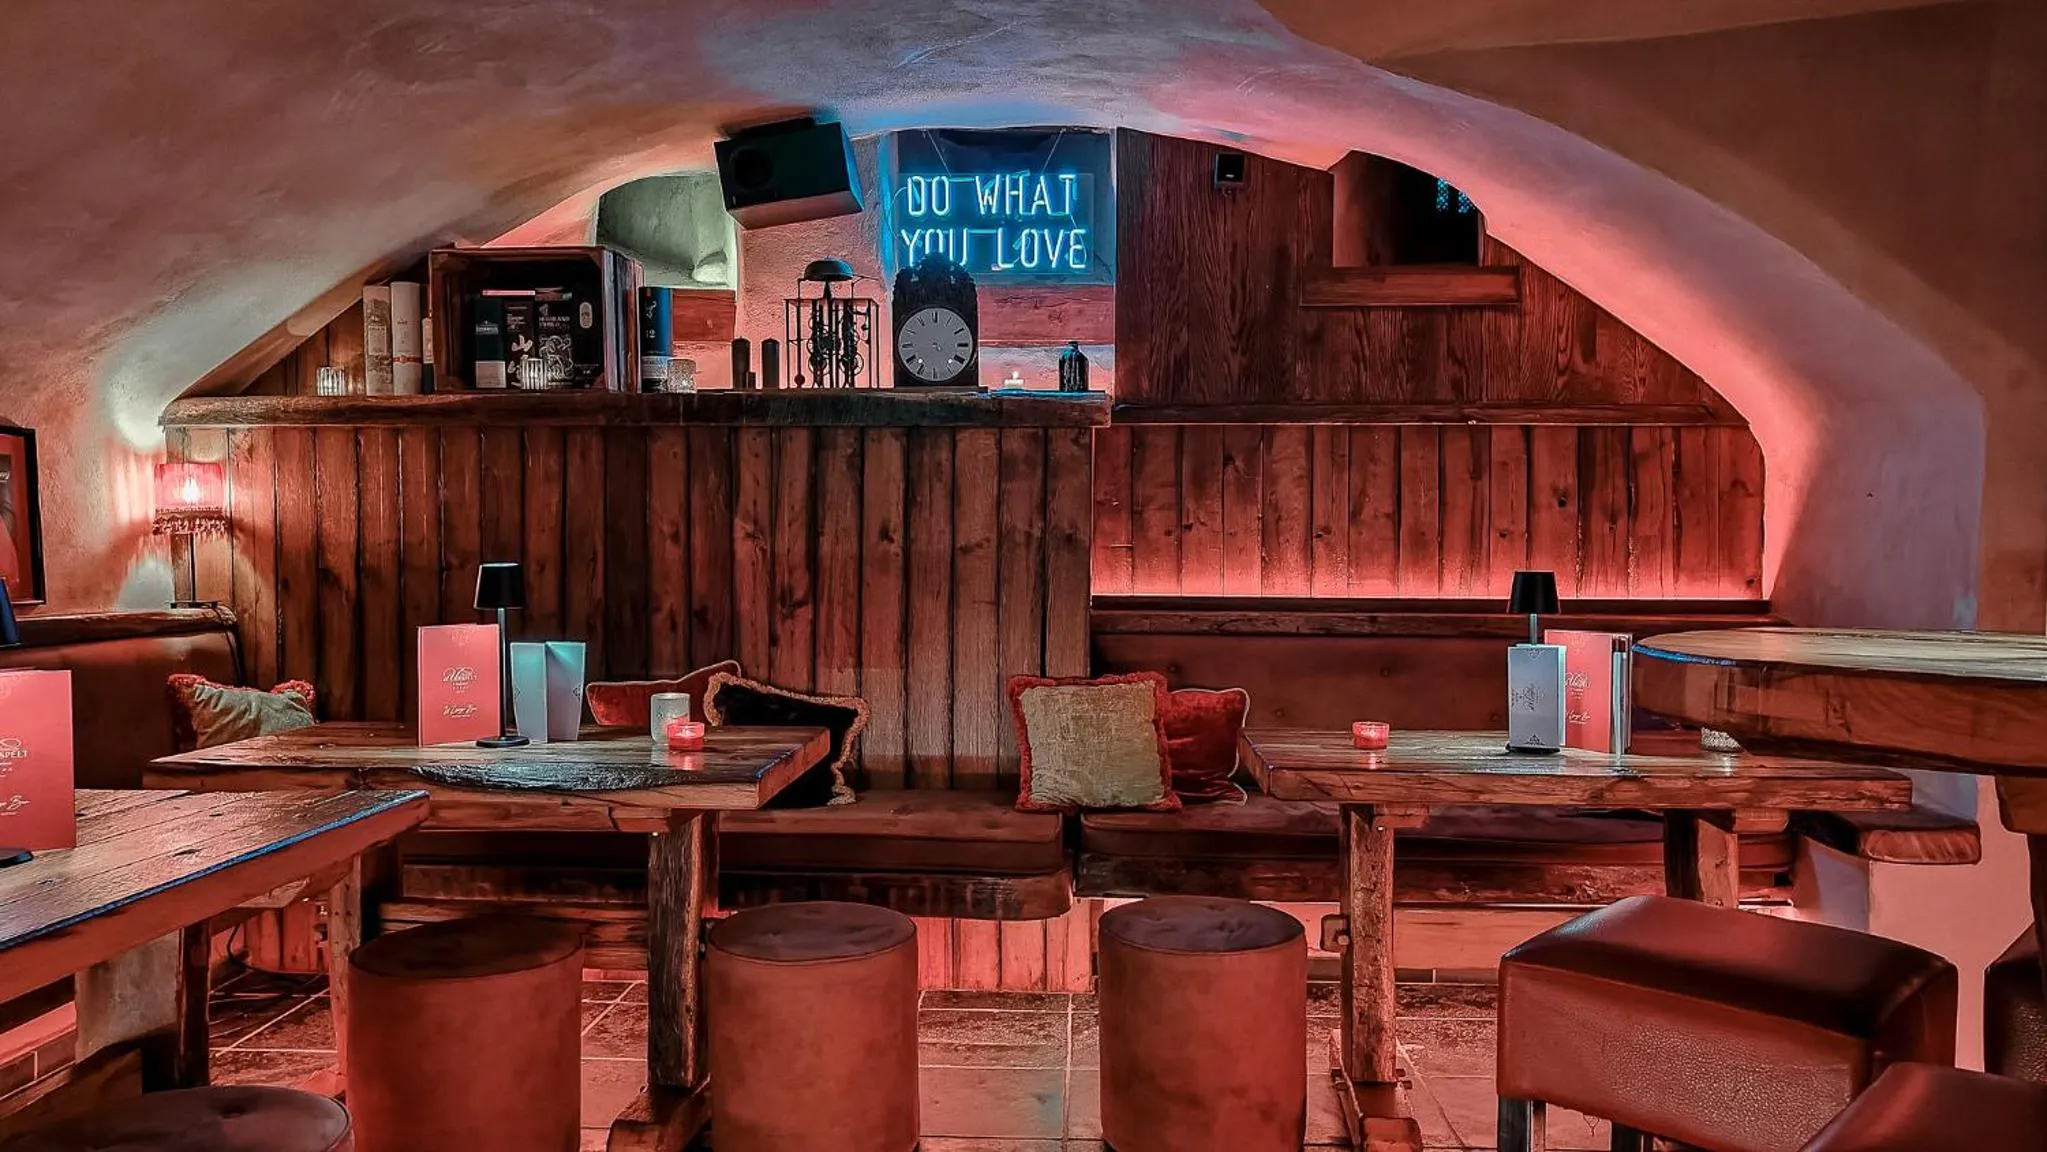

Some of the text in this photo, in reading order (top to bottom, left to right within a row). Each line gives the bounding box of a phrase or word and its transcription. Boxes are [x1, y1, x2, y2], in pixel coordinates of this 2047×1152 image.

[907, 173, 1077, 217] DO WHAT
[901, 227, 1087, 269] YOU LOVE
